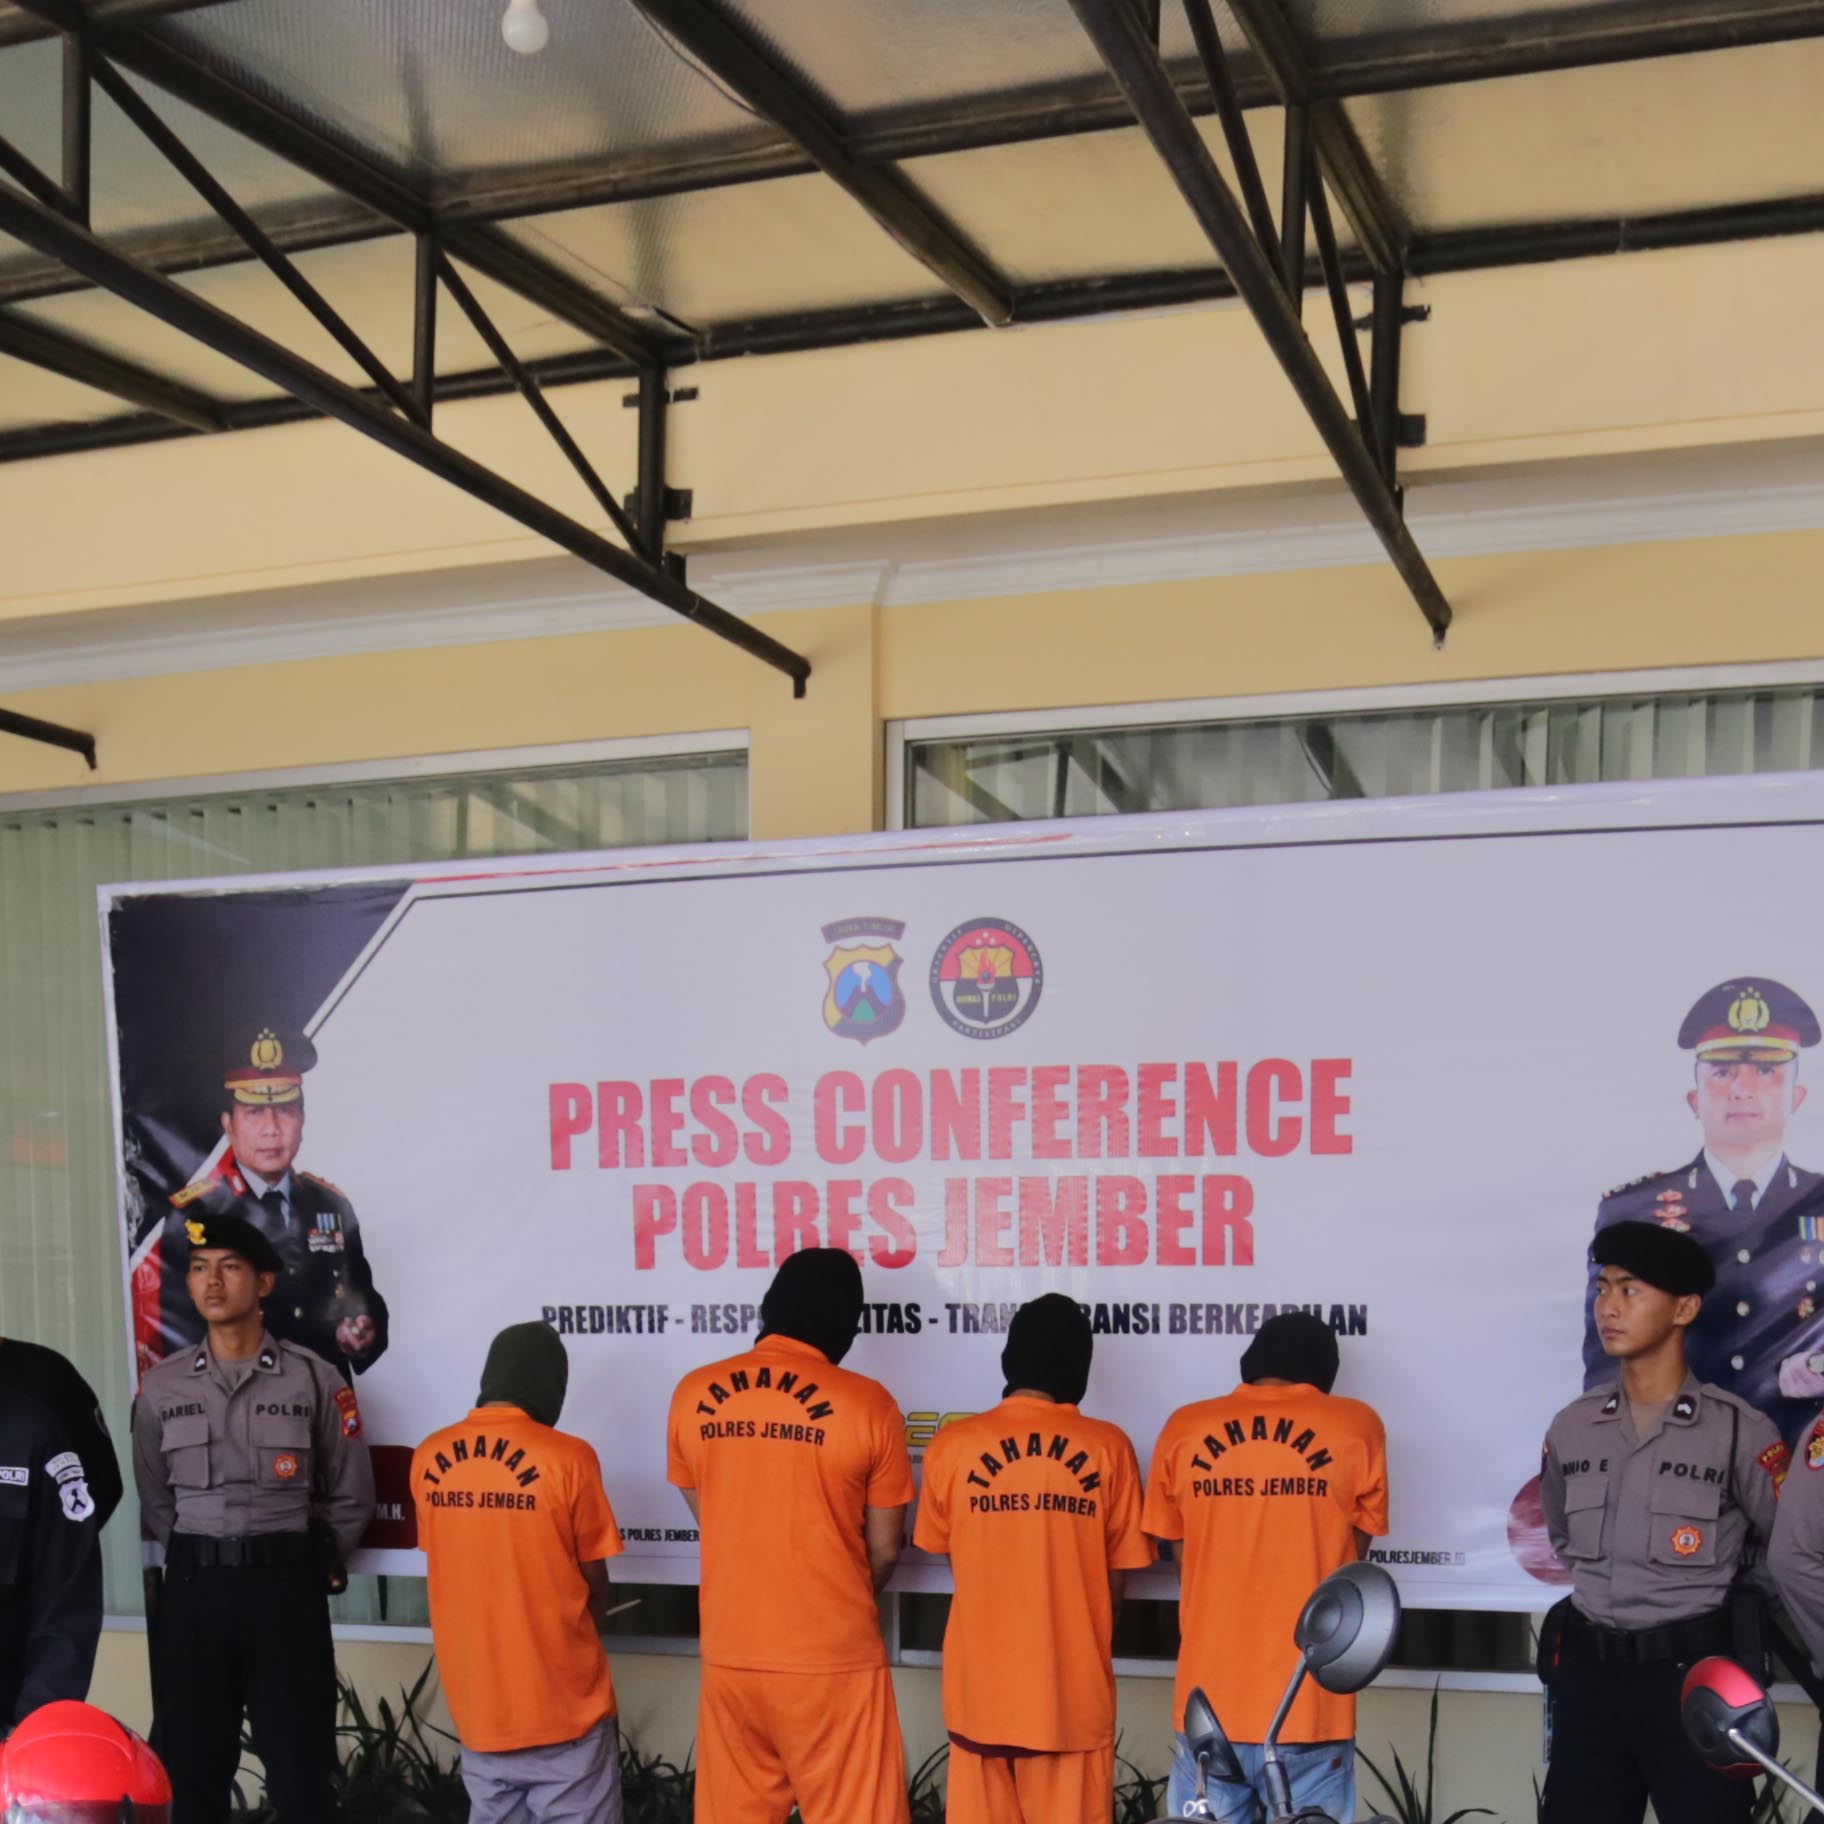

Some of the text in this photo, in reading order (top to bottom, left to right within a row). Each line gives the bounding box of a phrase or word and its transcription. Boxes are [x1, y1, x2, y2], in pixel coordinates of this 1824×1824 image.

[549, 1058, 1352, 1170] PRESS CONFERENCE
[632, 1174, 1254, 1270] POLRES JEMBER
[543, 1304, 669, 1335] PREDIKTIF
[697, 1366, 834, 1422] TAHANAN
[256, 1404, 310, 1418] POLRI
[701, 1421, 825, 1446] POLRES JEMBER
[1190, 1416, 1333, 1473] TAHANAN
[423, 1434, 540, 1488] TAHANAN
[966, 1432, 1102, 1493] TAHANAN
[1659, 1461, 1725, 1484] POLRI
[478, 1492, 536, 1511] JEMBER
[1193, 1477, 1328, 1498] POLRES JEMBER
[970, 1493, 1097, 1517] POLRES JEMBER
[628, 1528, 662, 1541] POLRES
[664, 1529, 699, 1542] JEMBER
